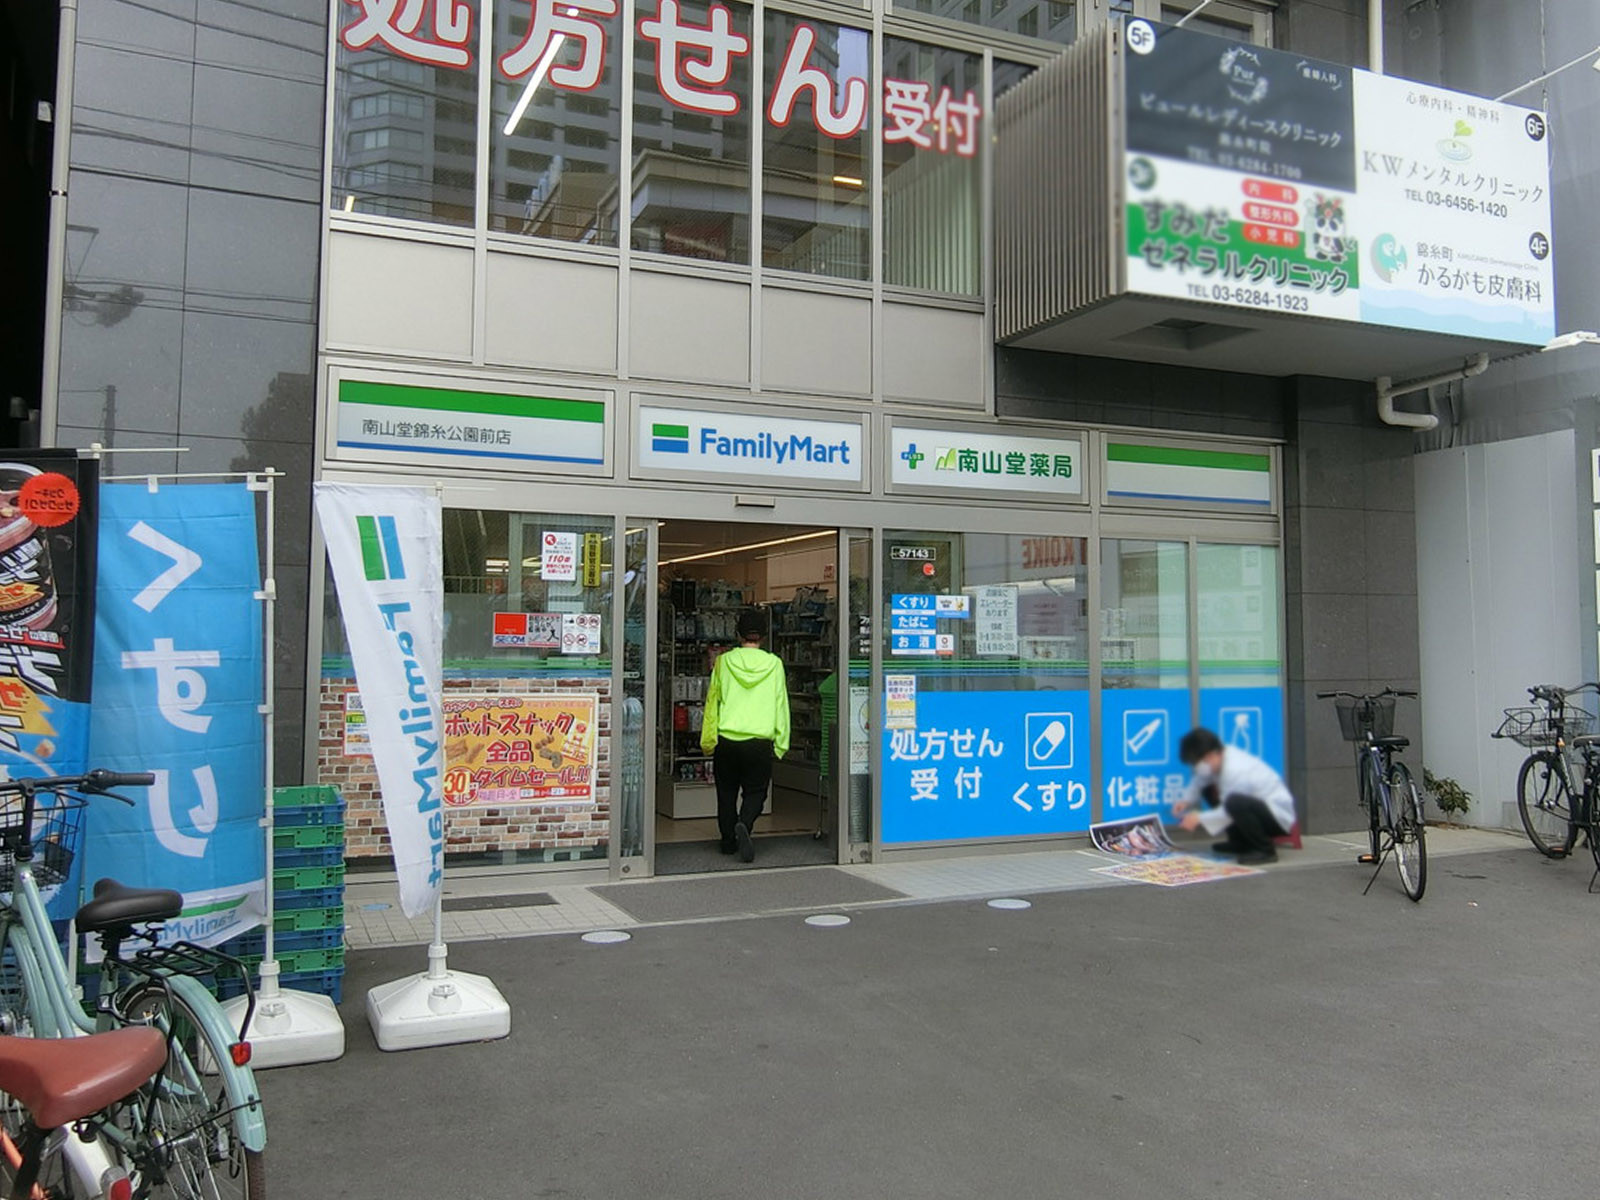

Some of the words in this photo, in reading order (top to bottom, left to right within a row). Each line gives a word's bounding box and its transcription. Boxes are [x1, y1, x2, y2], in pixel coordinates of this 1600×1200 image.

[1130, 26, 1152, 47] 5F
[341, 0, 867, 139] 処方せん
[884, 79, 981, 157] 受付
[1406, 90, 1501, 123] 心療内科・精神科
[1526, 117, 1545, 136] 6F
[1249, 206, 1295, 224] 整形外科
[1405, 188, 1424, 203] TEL
[1426, 190, 1508, 219] 03-6456-1420
[1141, 198, 1230, 244] すみだ
[1249, 229, 1295, 245] 小児科
[1530, 238, 1548, 255] 4F
[1417, 242, 1454, 262] 錦糸町
[1141, 237, 1349, 295] ゼネラルクリニック
[1418, 264, 1542, 303] かるがも皮膚科
[1187, 284, 1210, 298] TEL
[1212, 286, 1309, 311] 03-6284-1923
[362, 419, 512, 445] 南山堂錦糸公園前店
[700, 427, 851, 466] FamilyMart
[958, 448, 1072, 478] 南山堂薬局
[899, 548, 929, 559] 57143
[898, 596, 929, 608] くすり
[898, 616, 929, 628] たばこ
[495, 635, 526, 644] SECOM
[898, 636, 929, 648] お酒
[444, 711, 574, 736] ホットスナック
[486, 740, 533, 763] 全品
[889, 727, 1003, 763] 処方せん
[909, 767, 983, 802] 受付
[1012, 781, 1088, 812] くすり
[1106, 773, 1188, 809] 化粧品
